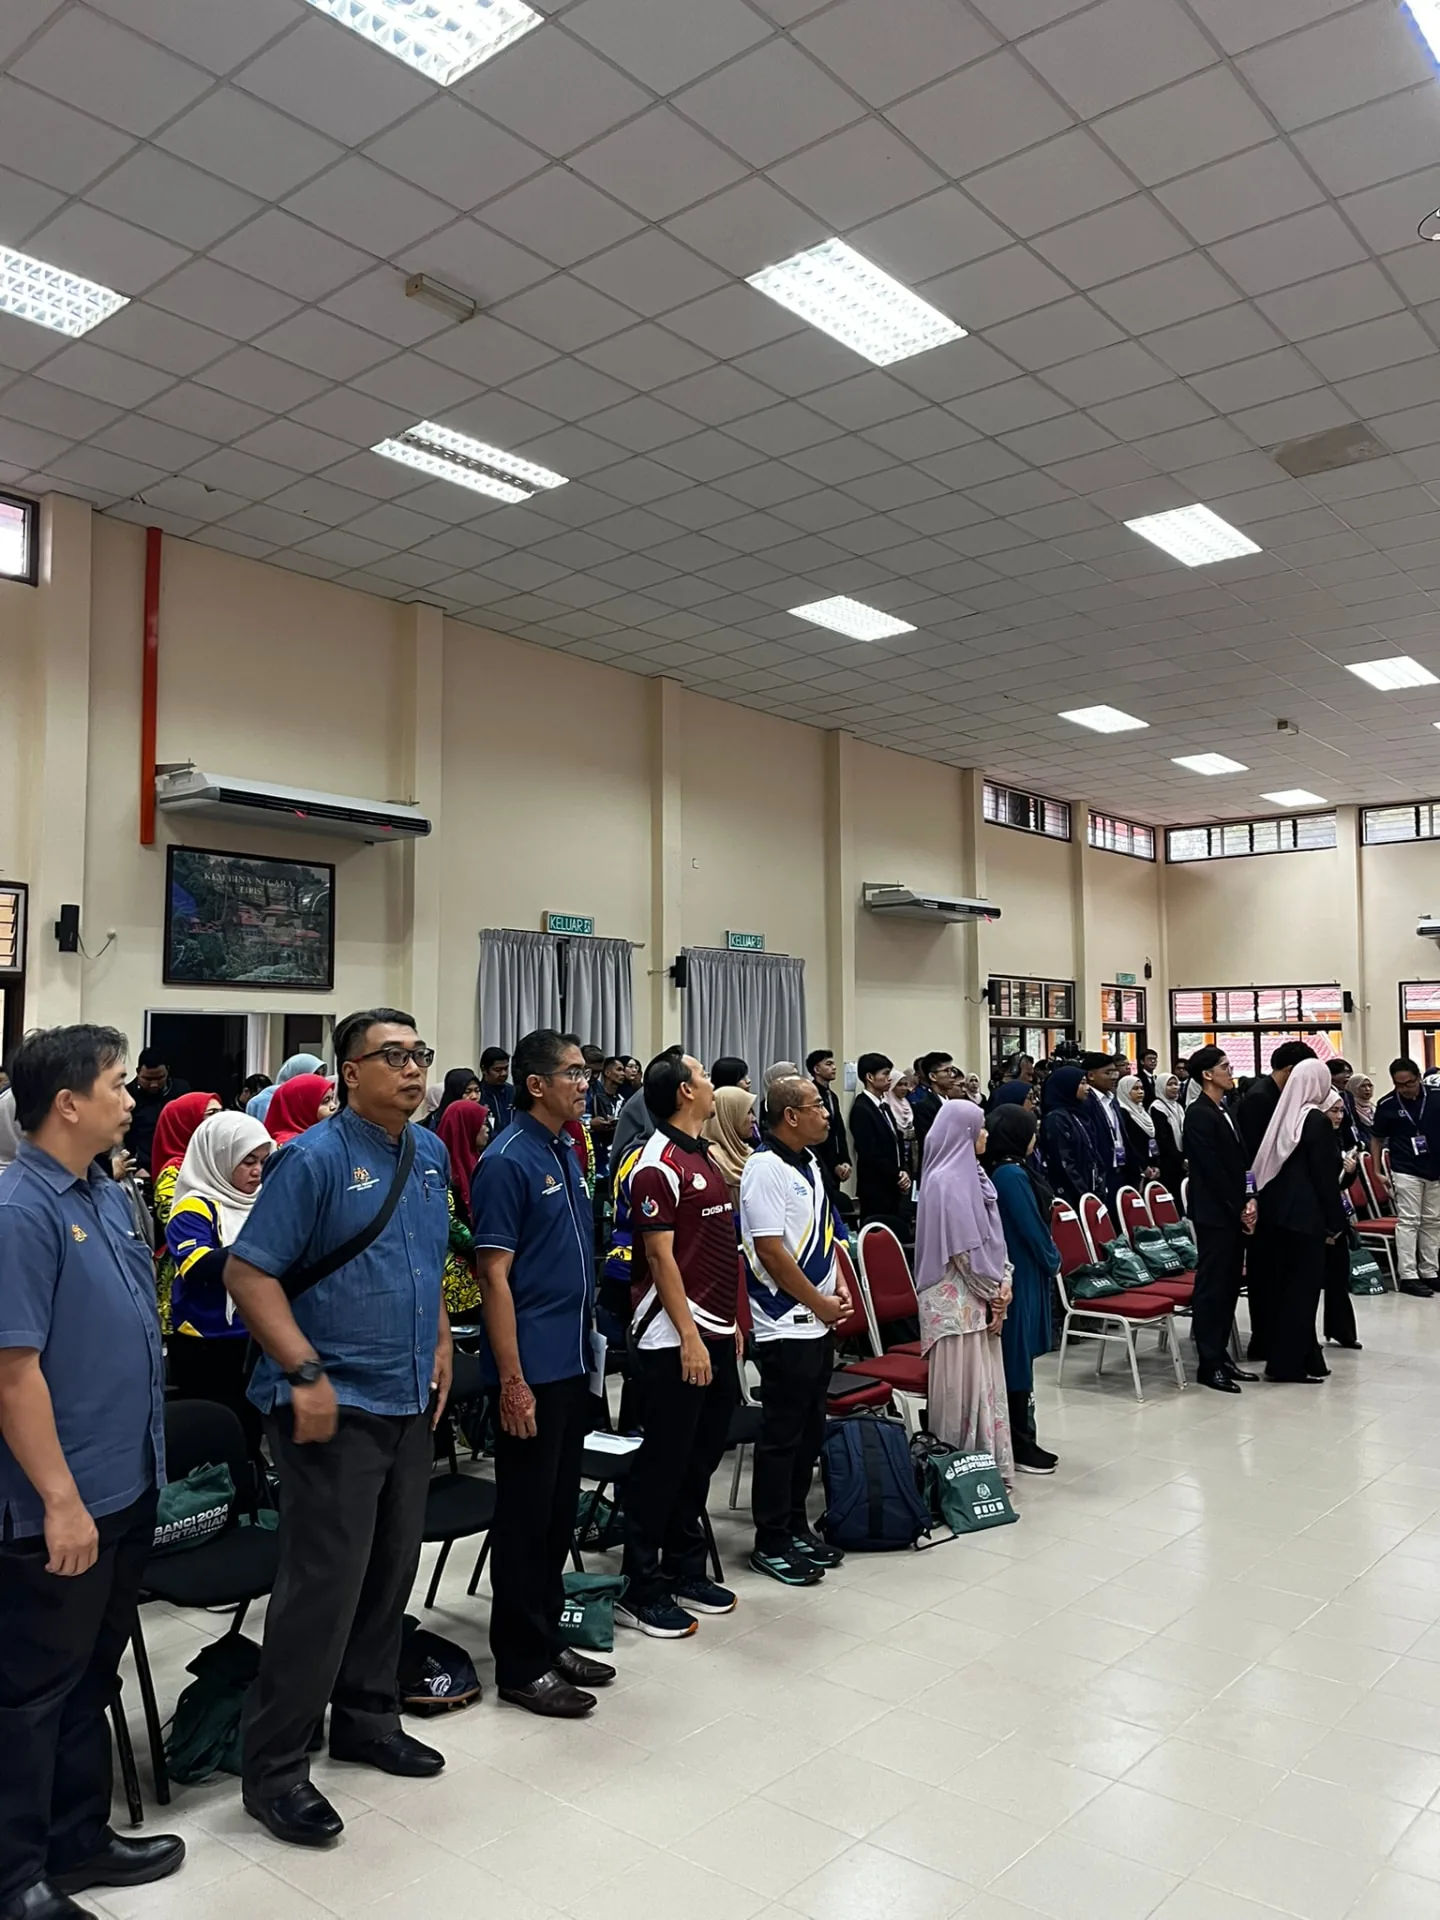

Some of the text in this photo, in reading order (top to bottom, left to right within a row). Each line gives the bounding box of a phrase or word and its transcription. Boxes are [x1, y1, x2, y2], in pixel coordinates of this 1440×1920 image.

[550, 916, 583, 932] KELUAR
[731, 935, 757, 947] KELUAR
[152, 1512, 228, 1547] PERTANIAN
[154, 1515, 196, 1537] BANCI
[196, 1503, 229, 1523] 2024
